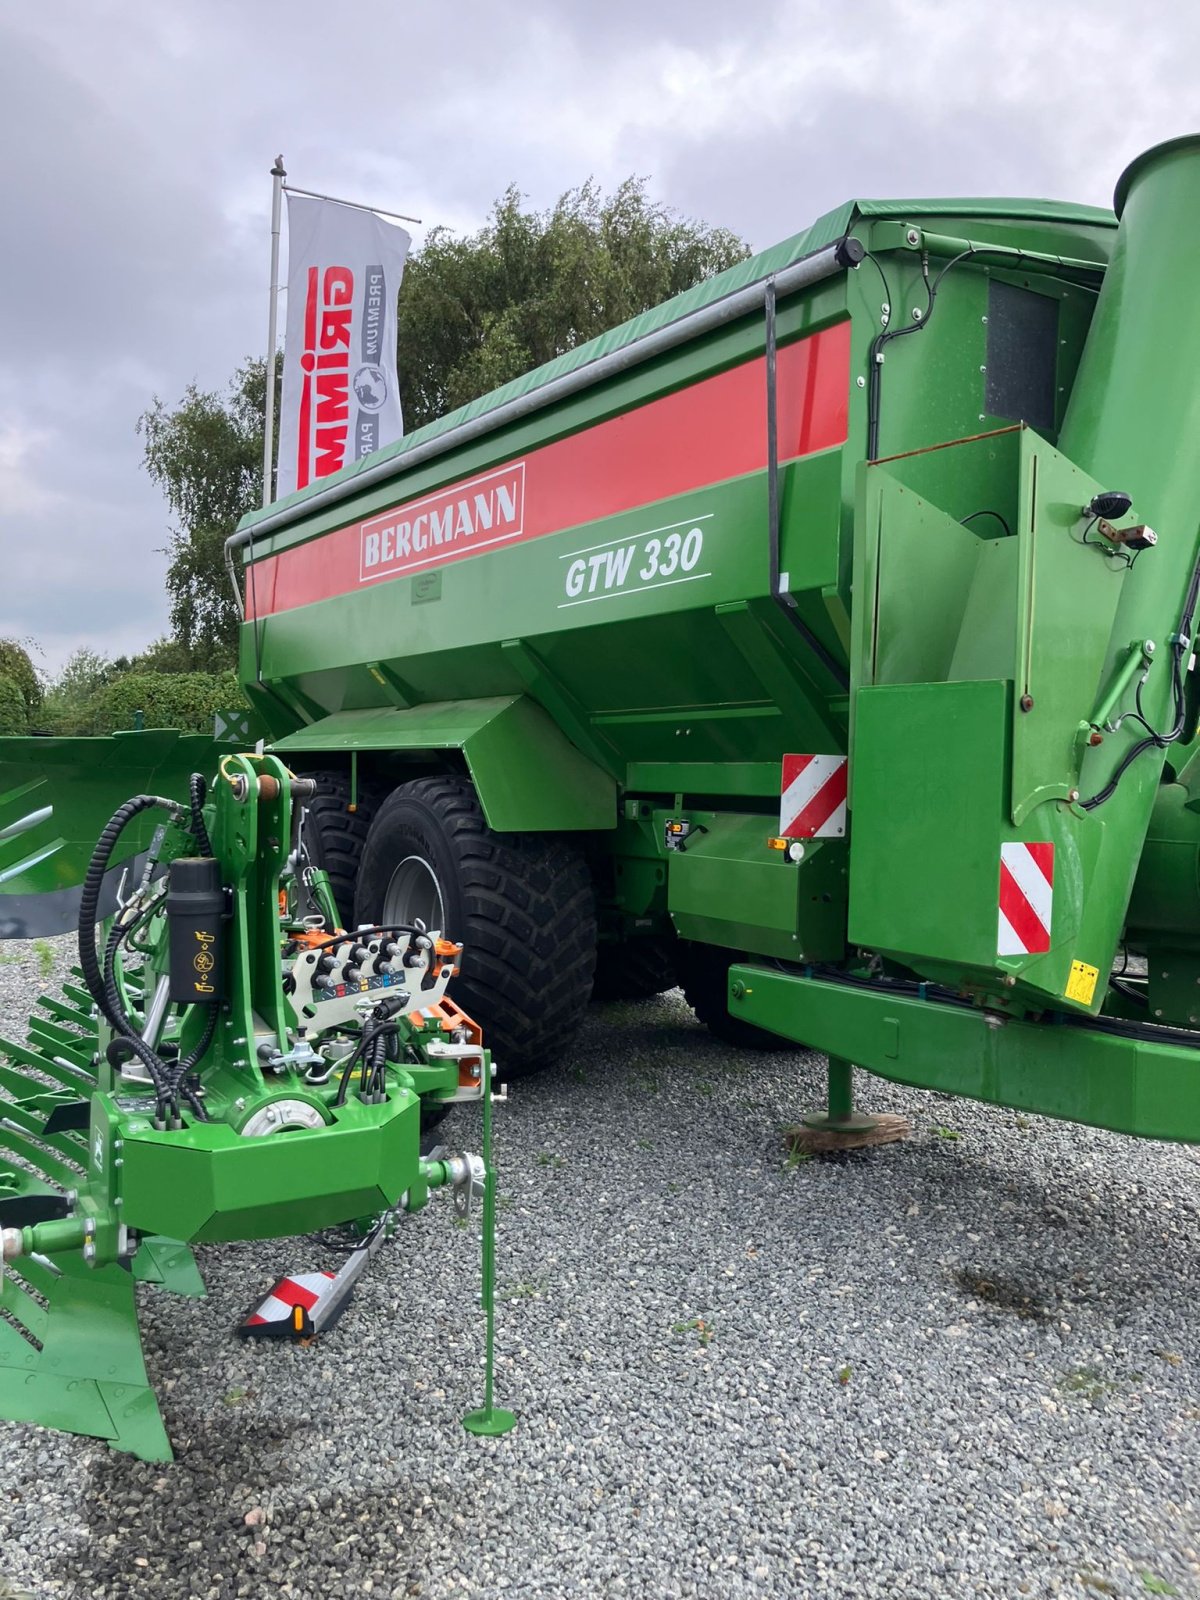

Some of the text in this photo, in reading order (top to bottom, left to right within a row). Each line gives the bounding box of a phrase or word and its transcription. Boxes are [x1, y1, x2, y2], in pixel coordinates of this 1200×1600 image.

[364, 481, 517, 568] BERGMANN
[564, 527, 704, 598] GTW 330
